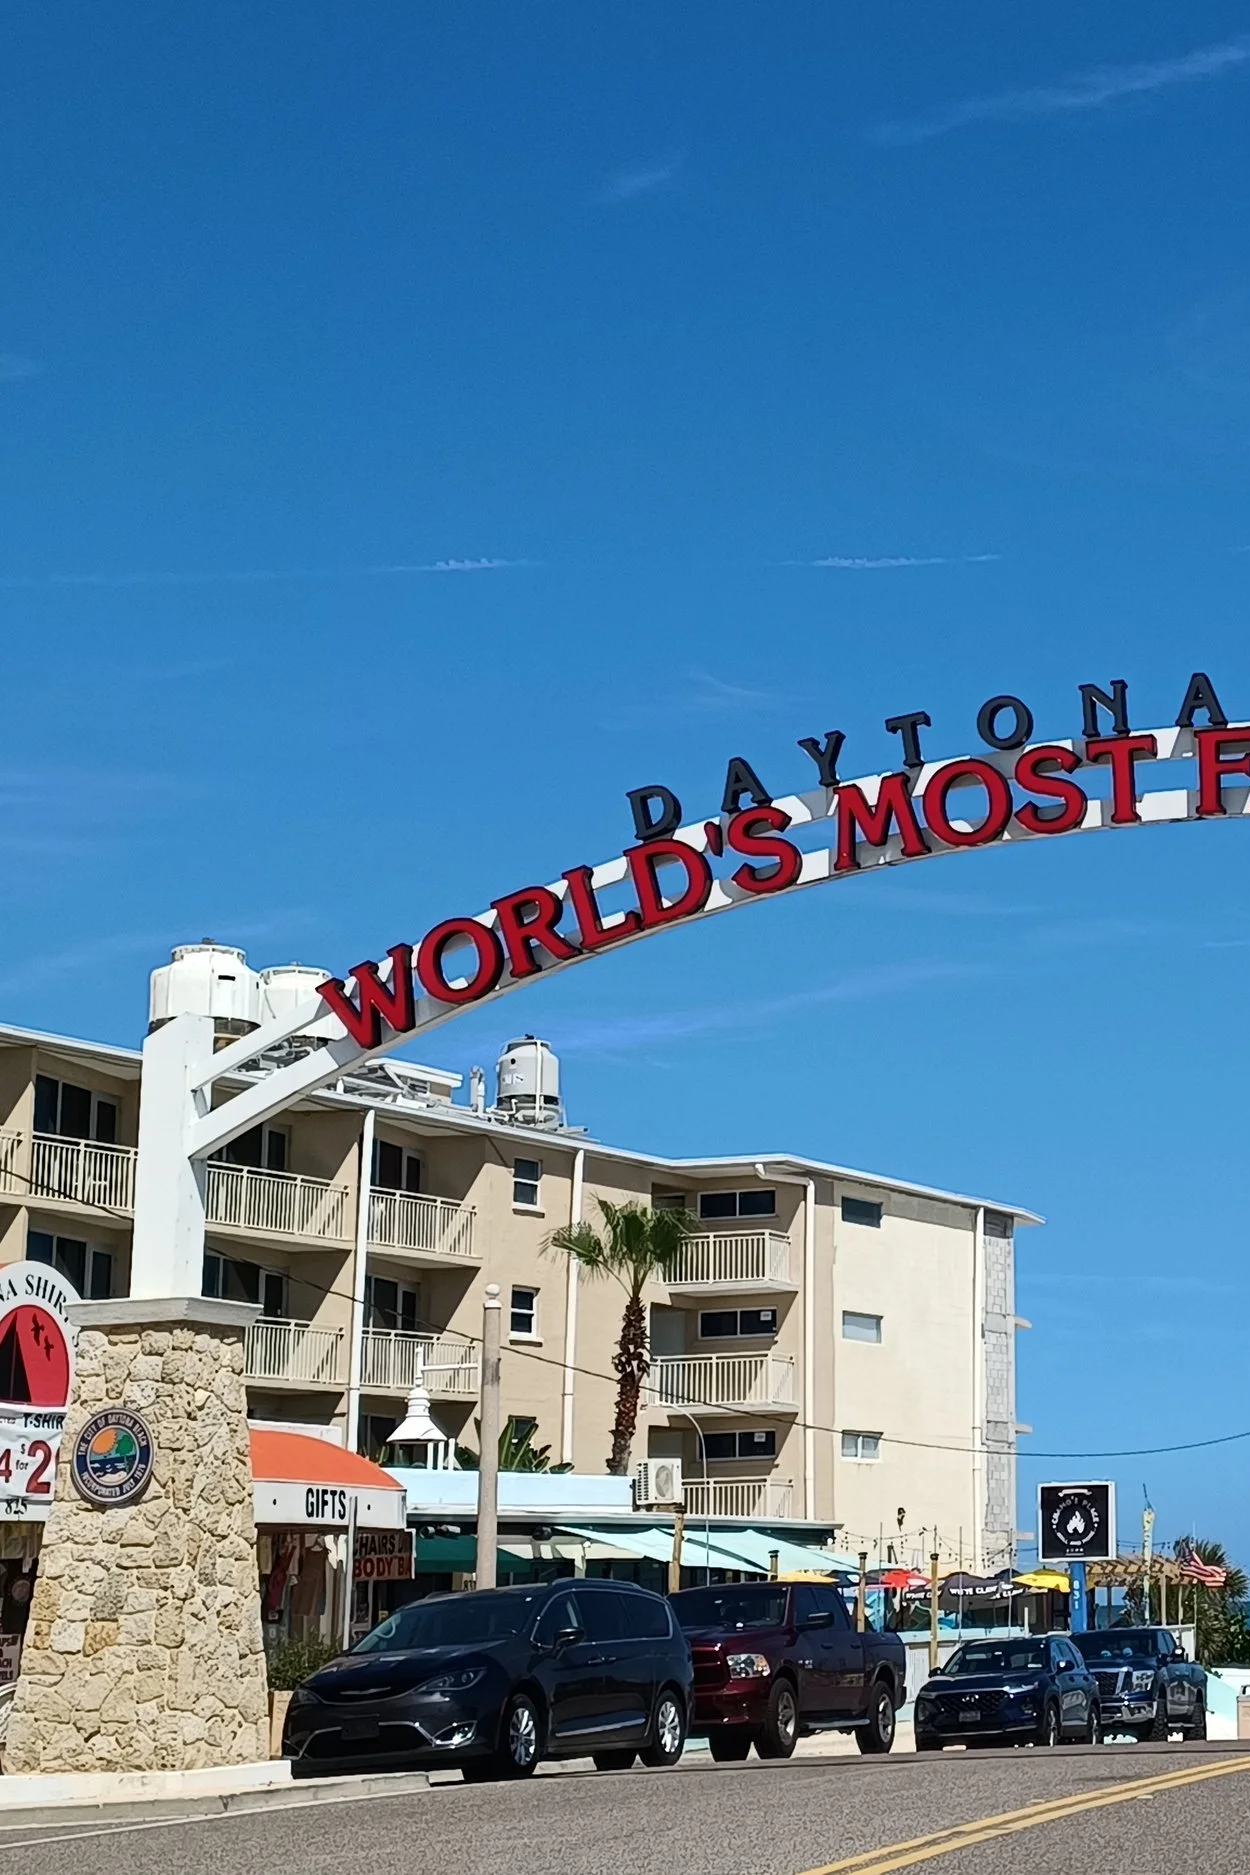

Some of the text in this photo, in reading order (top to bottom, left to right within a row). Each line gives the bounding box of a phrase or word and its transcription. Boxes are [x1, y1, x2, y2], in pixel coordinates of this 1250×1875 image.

[625, 672, 1227, 840] DAYTONA
[315, 805, 803, 1050] WORLD'S
[831, 734, 1157, 872] MOST
[78, 1414, 148, 1455] THE CITY OF DAYTONA BEACH
[306, 1487, 346, 1520] GIFTS
[354, 1557, 394, 1578] BODY
[1072, 1580, 1081, 1610] 831
